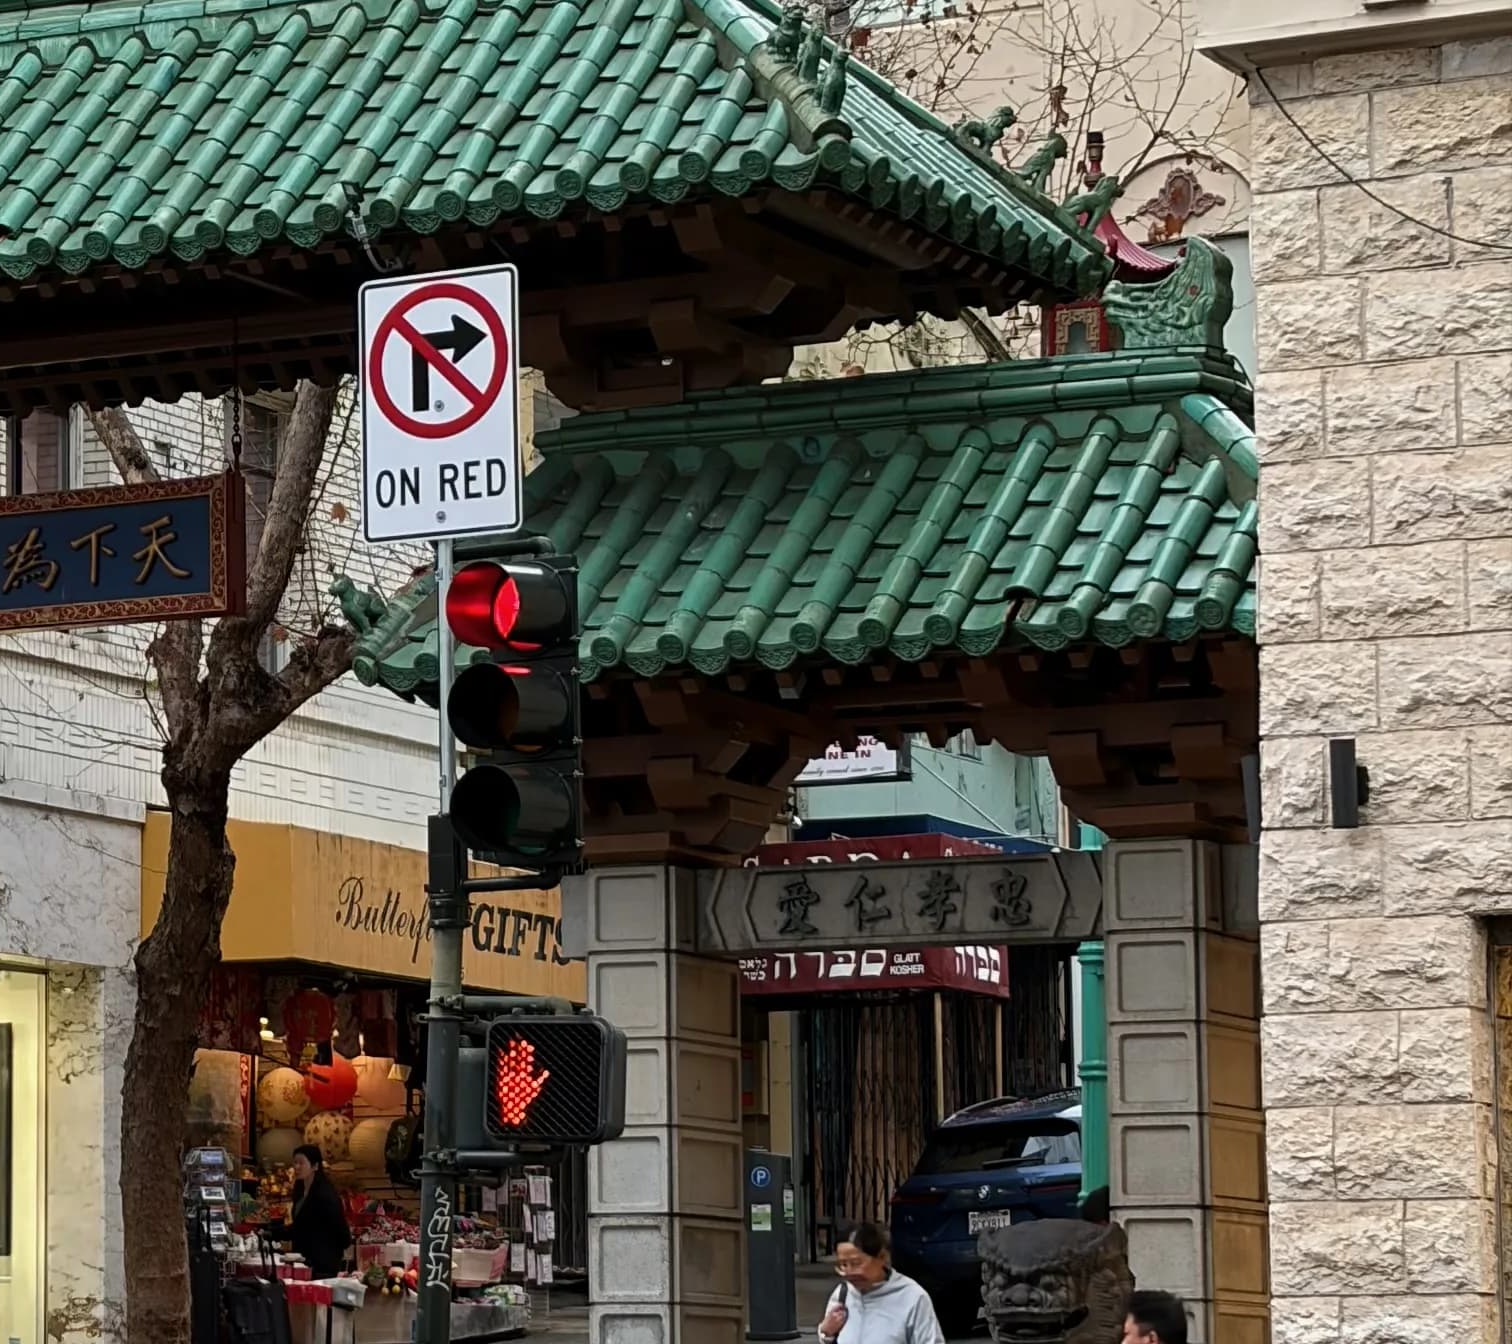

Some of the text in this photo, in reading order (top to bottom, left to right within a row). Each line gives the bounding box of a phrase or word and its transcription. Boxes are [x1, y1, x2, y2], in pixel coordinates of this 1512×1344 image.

[376, 458, 506, 508] ON RED
[893, 952, 920, 964] GLATT
[889, 963, 925, 975] KOSHER
[757, 1170, 766, 1184] P
